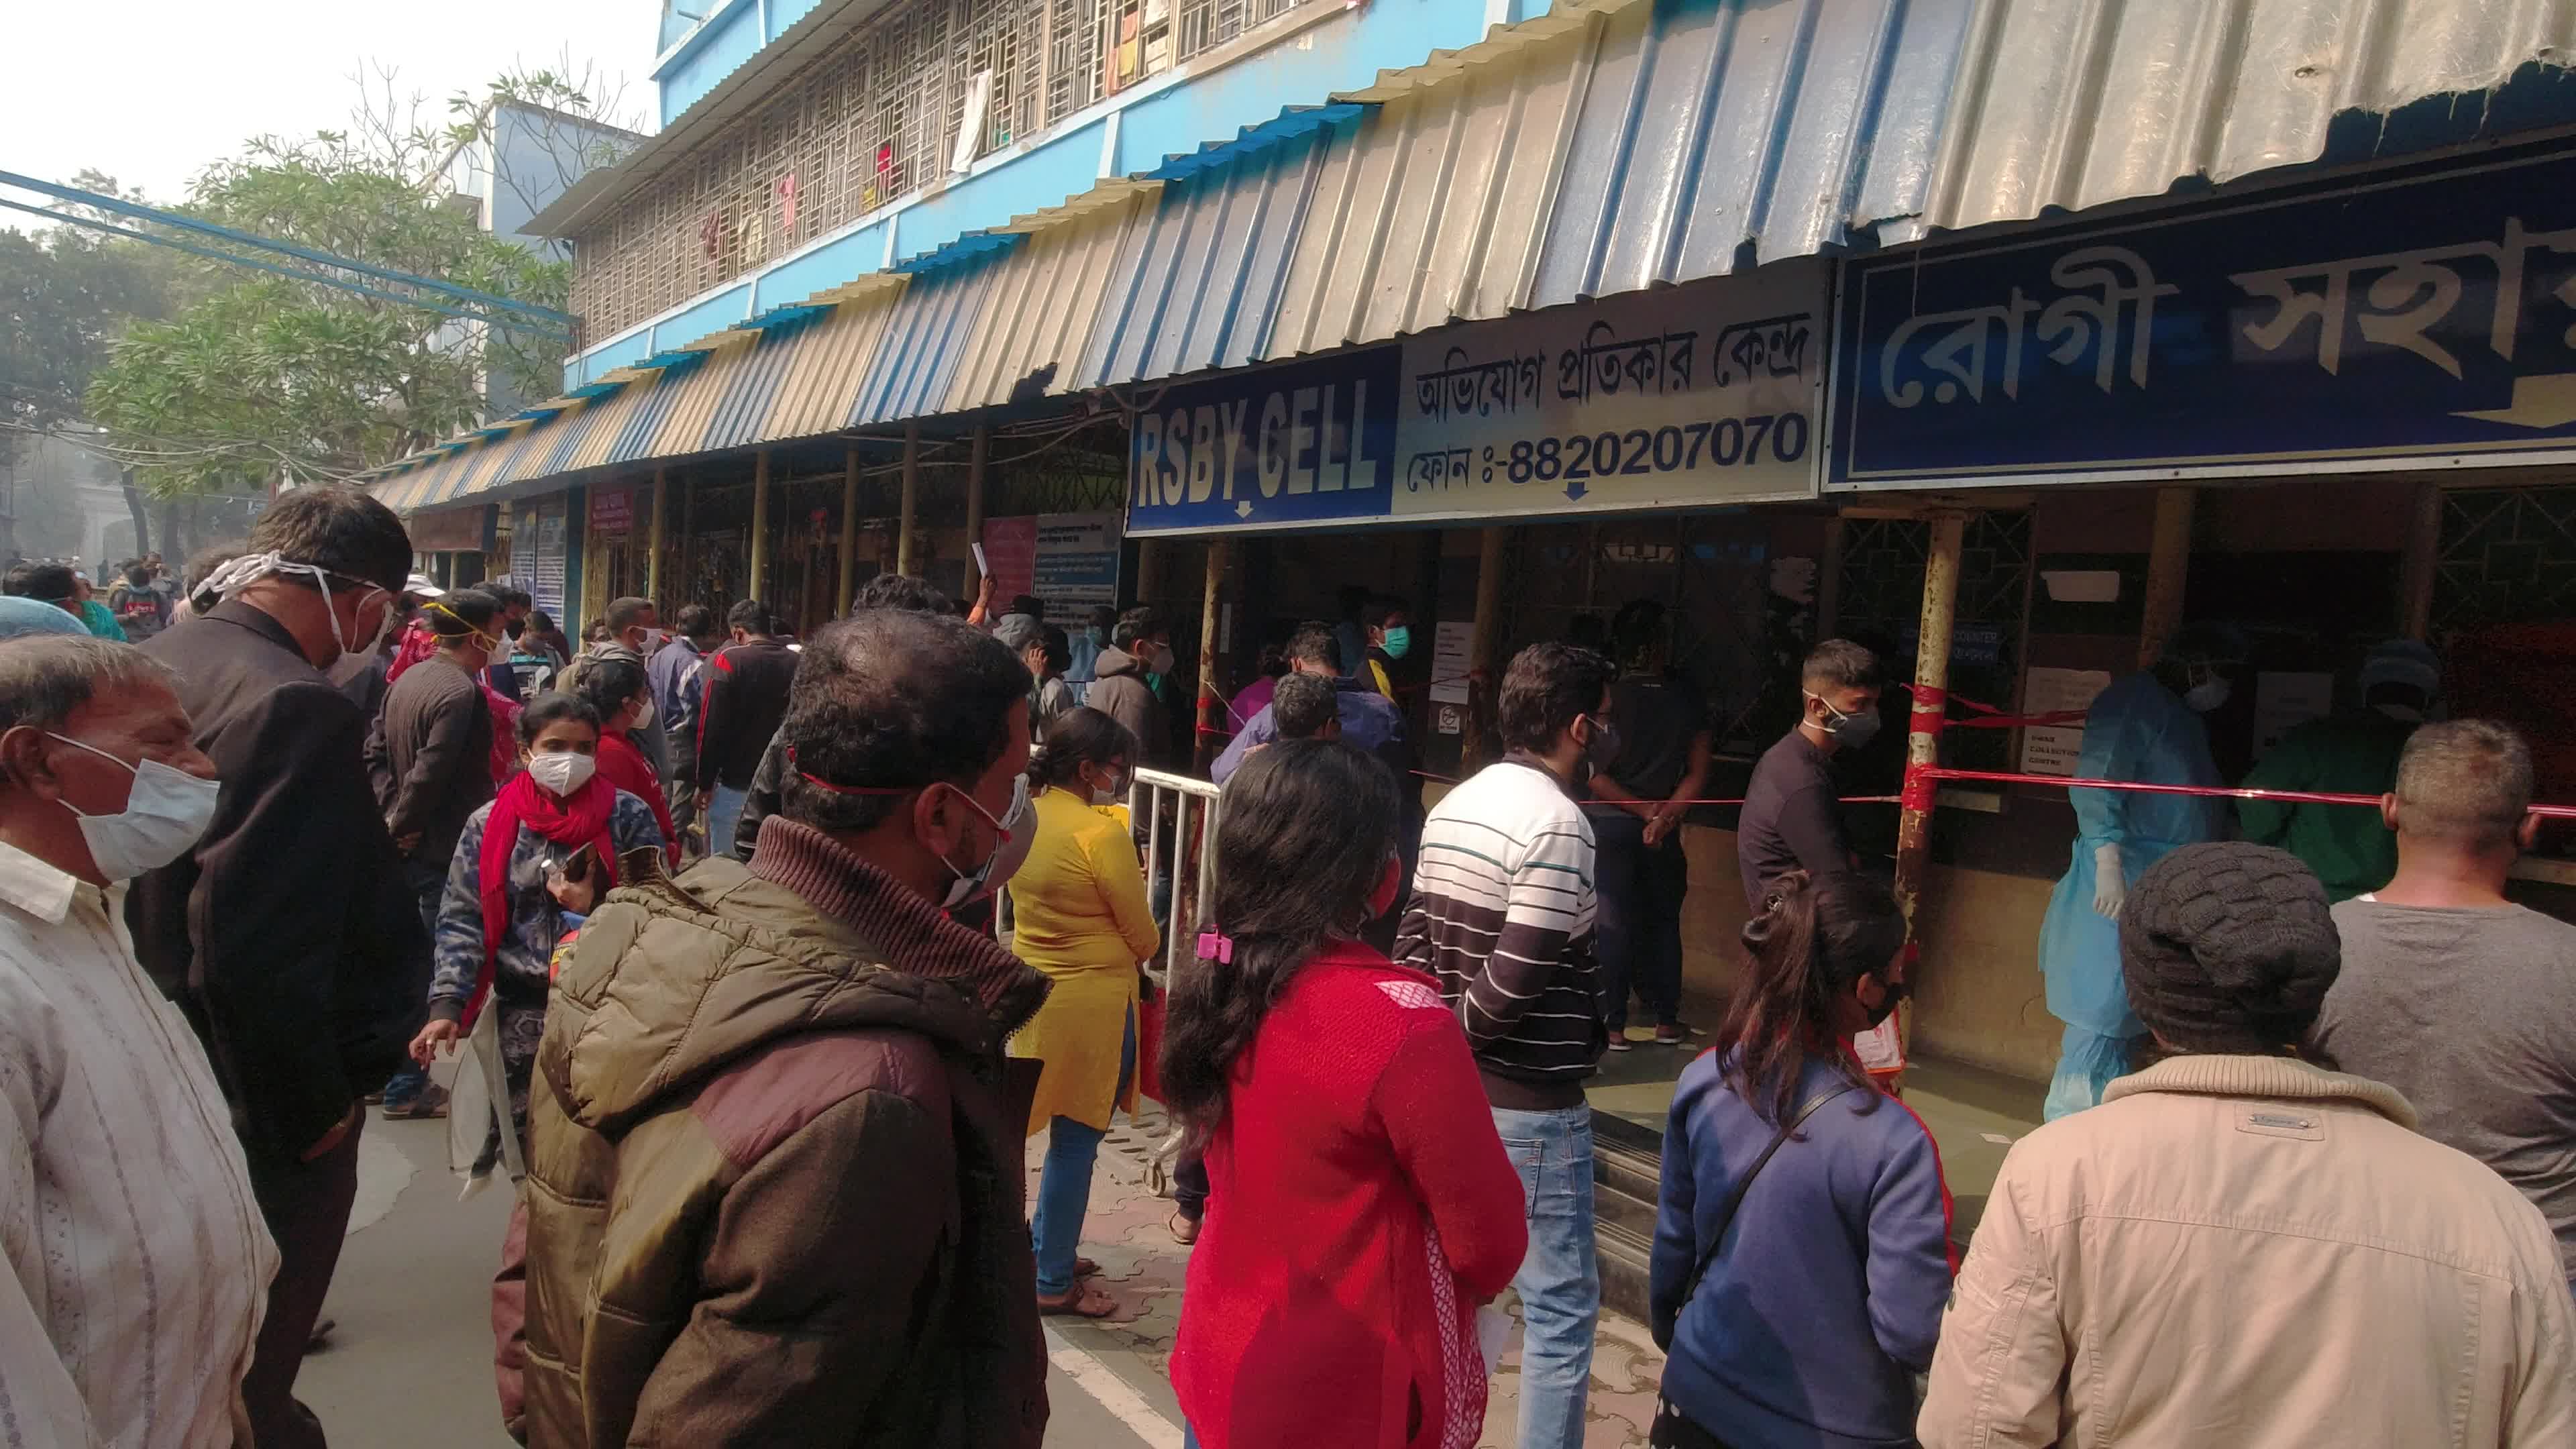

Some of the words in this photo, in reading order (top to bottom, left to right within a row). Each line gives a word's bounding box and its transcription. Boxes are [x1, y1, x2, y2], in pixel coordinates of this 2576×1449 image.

[1415, 346, 1546, 424] অভিযোগ
[1557, 320, 1699, 406] প্রতিকার
[1713, 313, 1812, 388] কেন্দ্র
[1880, 246, 2182, 409] রোগী
[1138, 398, 1248, 507] RSBY
[1258, 380, 1376, 498] CELL
[1409, 445, 1473, 492] ফোন
